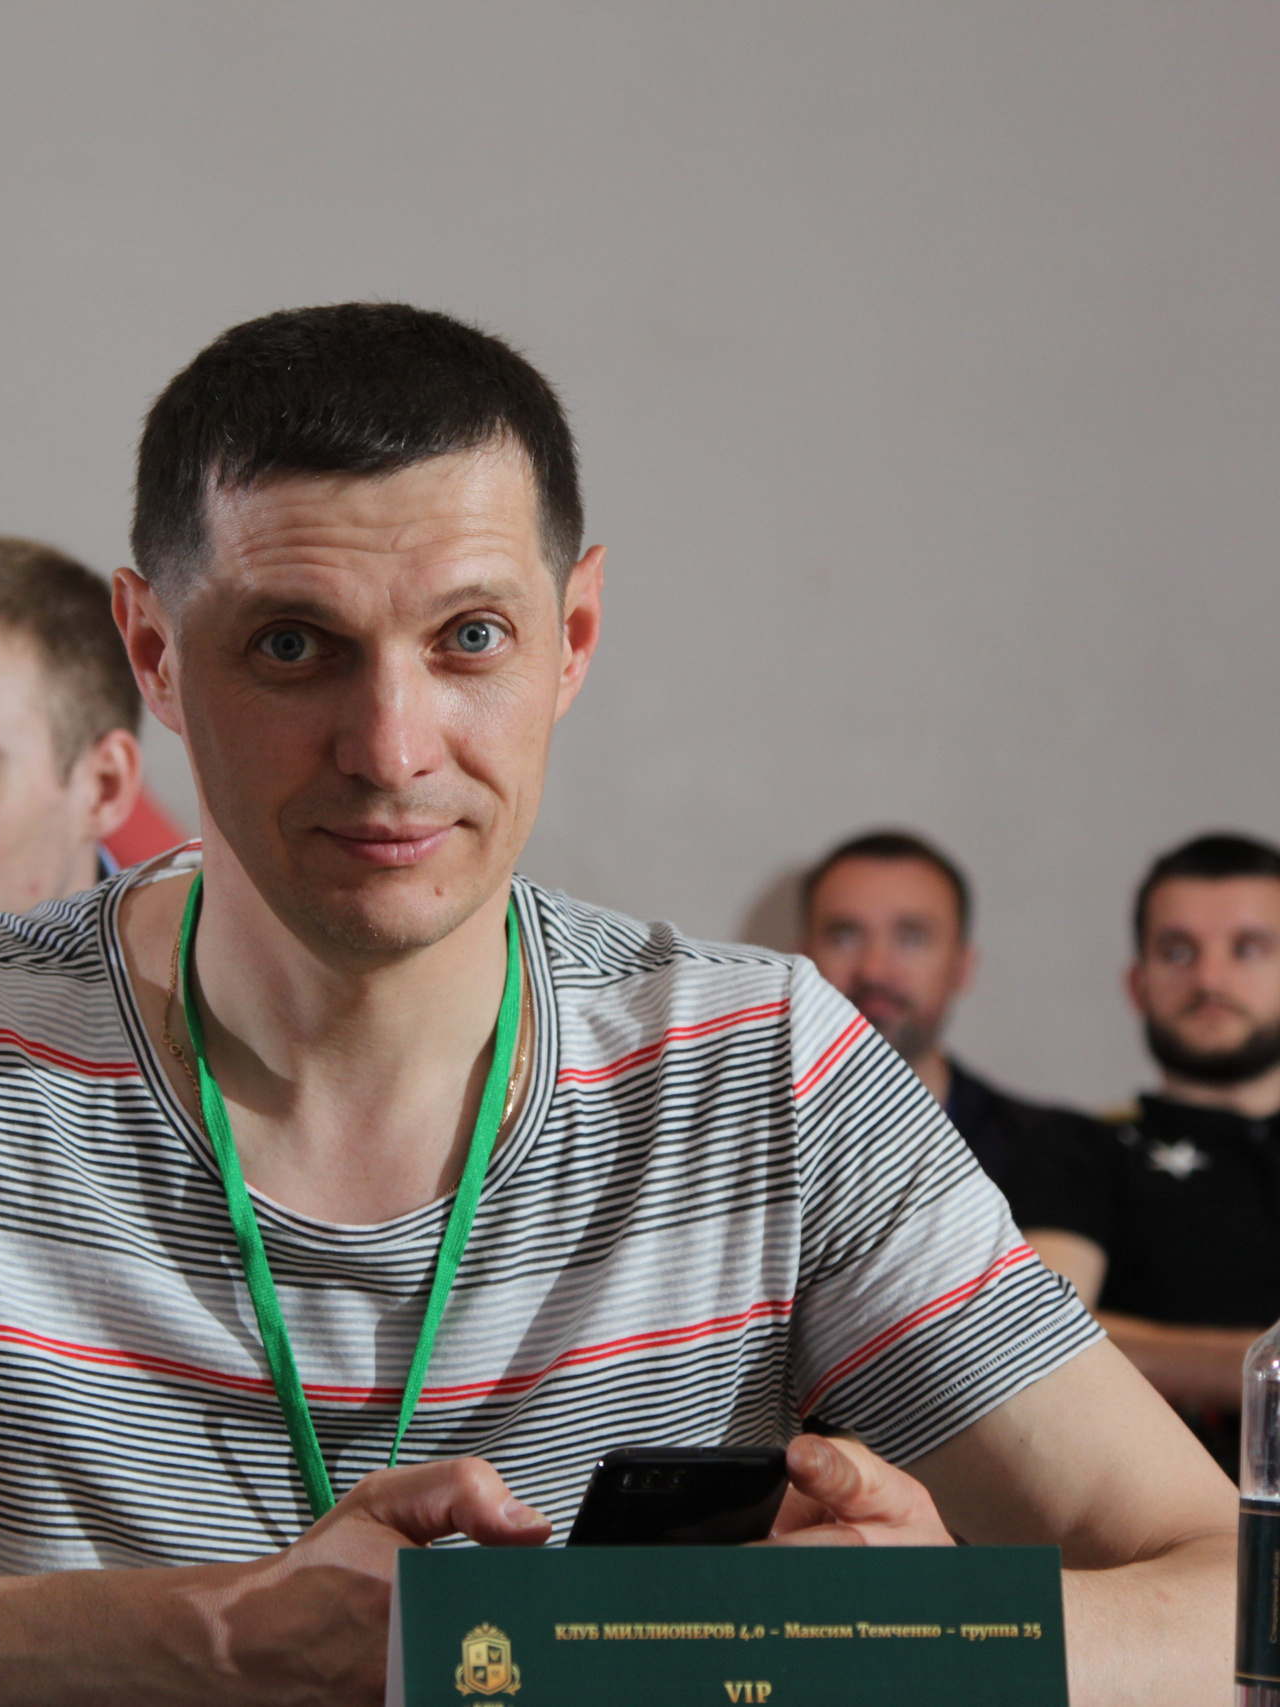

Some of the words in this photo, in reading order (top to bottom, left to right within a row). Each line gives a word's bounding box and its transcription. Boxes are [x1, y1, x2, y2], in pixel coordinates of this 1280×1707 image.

[554, 1622, 601, 1641] КЛУБ
[603, 1622, 736, 1640] МИЛЛИОНЕРОВ
[738, 1624, 766, 1643] 4.0
[783, 1621, 854, 1639] Максим
[856, 1621, 942, 1639] Темченко
[960, 1624, 1020, 1643] группа
[1022, 1622, 1043, 1641] 25
[724, 1680, 773, 1703] VIP
